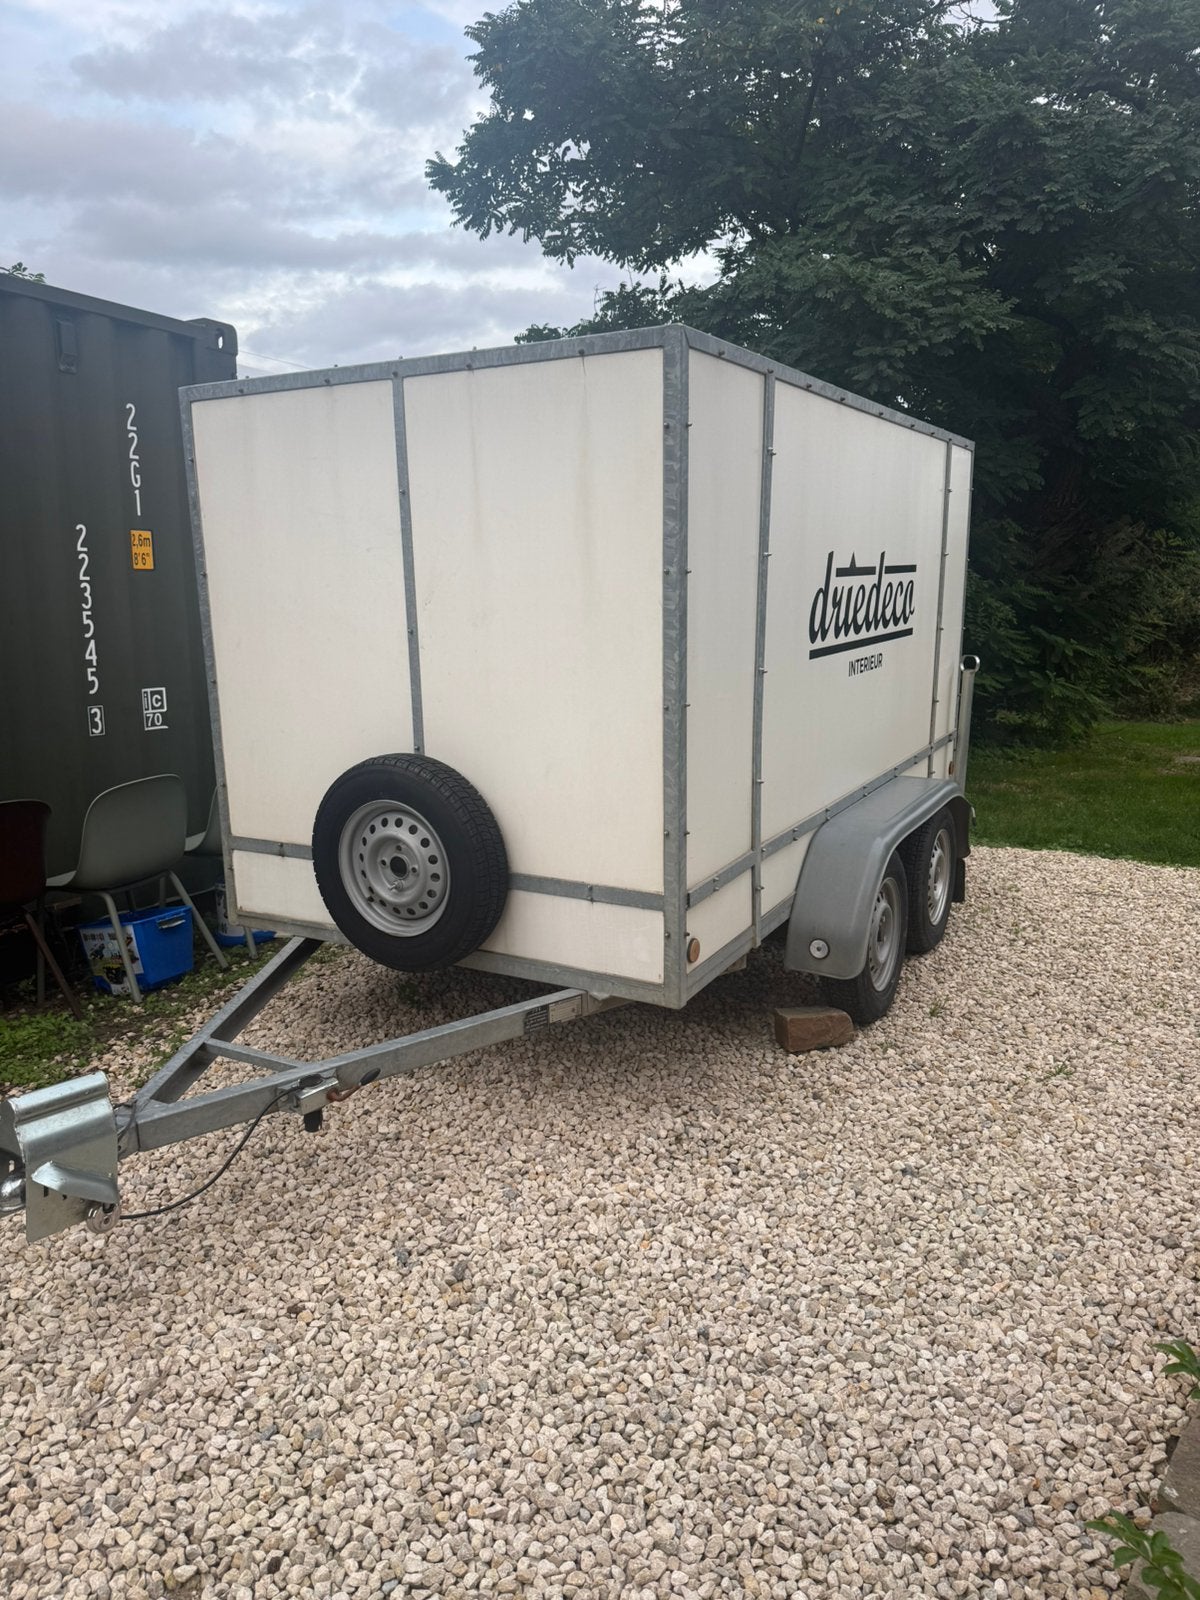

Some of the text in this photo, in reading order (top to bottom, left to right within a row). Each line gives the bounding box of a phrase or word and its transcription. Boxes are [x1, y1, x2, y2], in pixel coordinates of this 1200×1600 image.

[126, 403, 141, 516] 22G1
[131, 533, 151, 548] 2,6m
[808, 550, 915, 645] druedeco
[75, 524, 102, 734] 223545 3
[848, 653, 883, 677] INTERIEUR
[146, 712, 162, 727] 70
